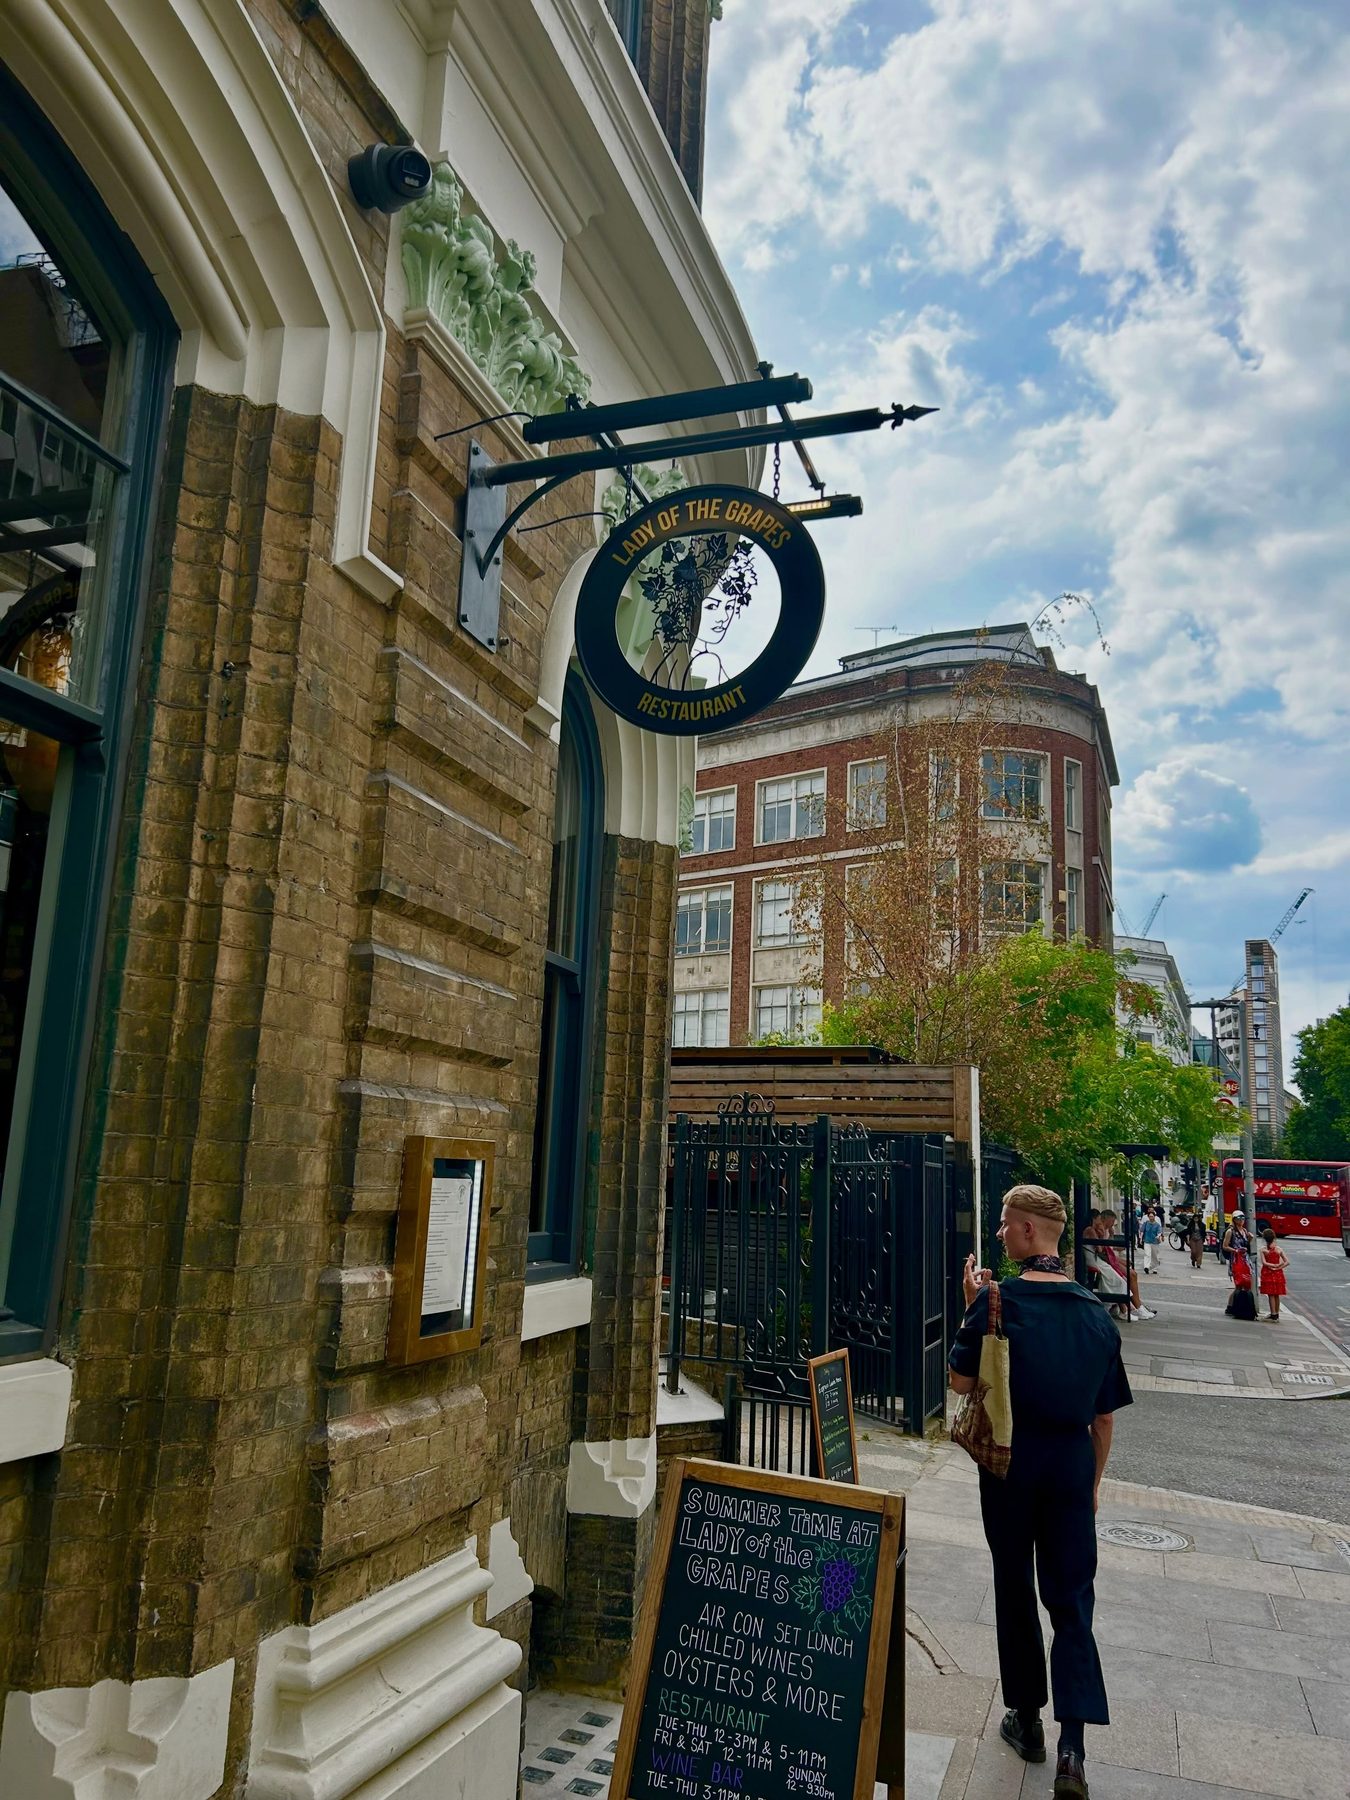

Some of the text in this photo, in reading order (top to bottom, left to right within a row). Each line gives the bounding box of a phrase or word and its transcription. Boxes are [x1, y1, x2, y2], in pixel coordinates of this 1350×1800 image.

[612, 498, 792, 566] LADY OF THE GRAPES
[637, 685, 747, 721] RESTAURANT
[684, 1488, 781, 1527] SUMMER
[846, 1520, 879, 1546] AT
[679, 1517, 813, 1569] LADY of the
[687, 1553, 790, 1604] GRAPES
[679, 1623, 814, 1681] CHILLED WINES
[698, 1602, 854, 1659] AIR CON SET LUNCH
[663, 1650, 845, 1722] OYSTERS & MORE
[658, 1688, 770, 1735] RESTAURANT
[658, 1713, 707, 1738] TUE-THU
[762, 1741, 772, 1756] &
[653, 1728, 673, 1747] FRI
[676, 1734, 686, 1748] &
[690, 1737, 712, 1755] SAT
[647, 1770, 698, 1797] TUE-THU
[652, 1746, 744, 1789] WINE BAR
[788, 1766, 829, 1786] SUNDAY
